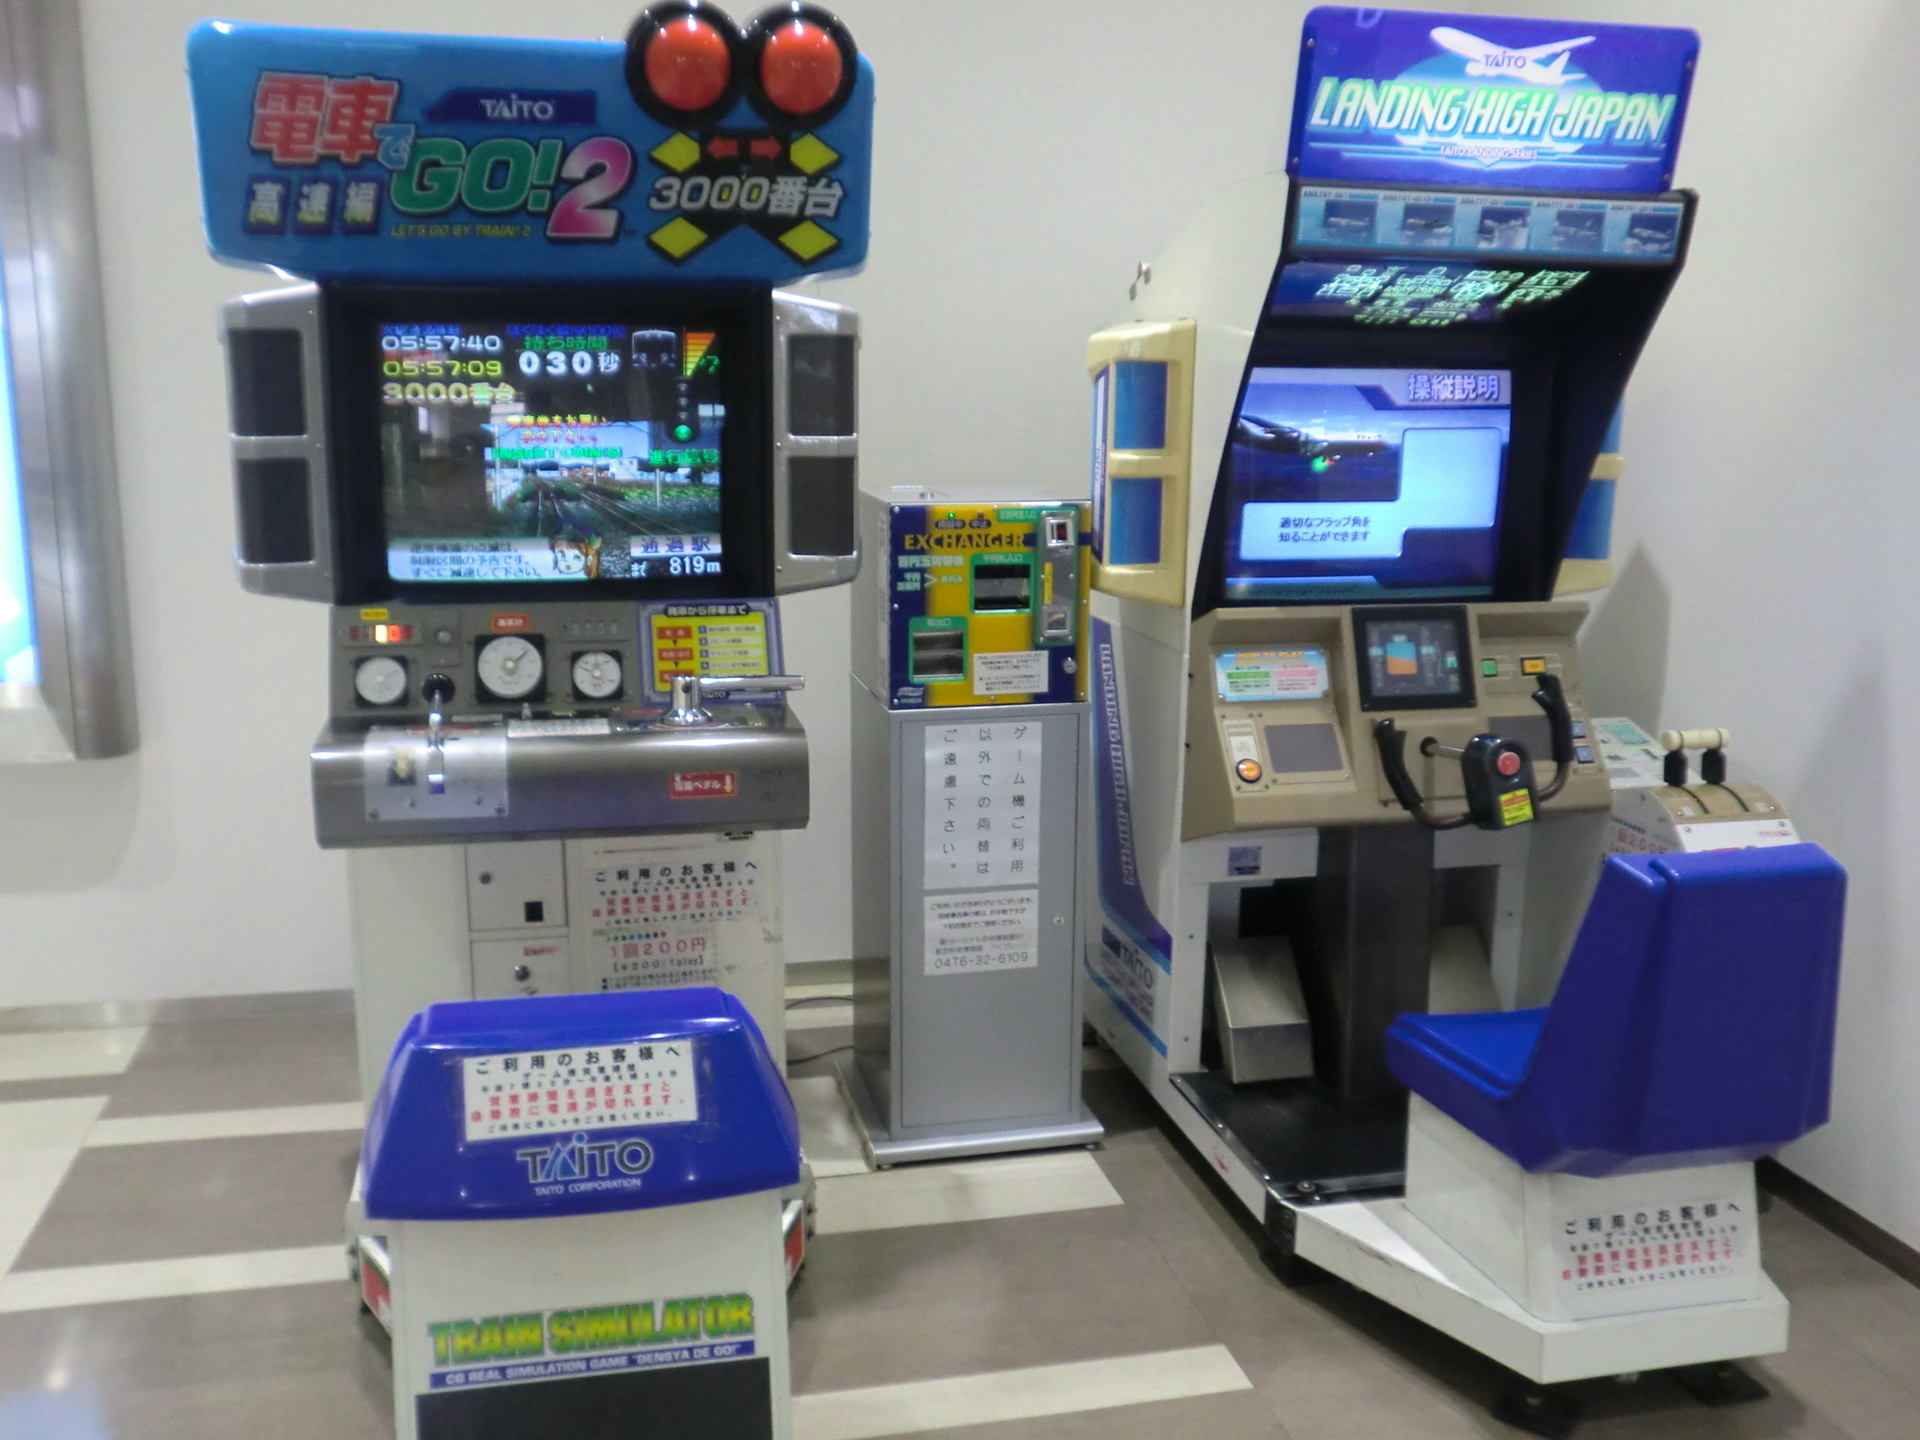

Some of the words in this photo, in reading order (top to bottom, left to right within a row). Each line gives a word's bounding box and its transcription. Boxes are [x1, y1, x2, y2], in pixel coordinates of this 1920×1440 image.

[1483, 50, 1526, 68] TAITO
[479, 93, 555, 120] TAITO
[1310, 76, 1464, 136] LANDING
[1464, 86, 1551, 140] HIGH
[1550, 91, 1676, 141] JAPAN
[546, 137, 632, 241] 2
[649, 174, 843, 218] 3000番台
[381, 335, 500, 350] 05:57:40
[524, 336, 609, 350] 持ち時間
[383, 360, 502, 376] 05:57:09
[1408, 374, 1499, 400] 操縦説明
[649, 449, 720, 465] 進行信号
[1280, 517, 1371, 528] 適切なフラップ角を
[641, 536, 710, 554] 通過駅
[904, 533, 1025, 550] EXCHANGER
[1278, 530, 1371, 542] 知ることができます
[977, 727, 992, 874] 以外での両替は
[1010, 725, 1027, 873] ゲーム機ご利用
[596, 862, 757, 883] ご利用のお客様へ
[934, 951, 1028, 969] 0476-32-6109
[476, 1047, 680, 1075] ご利用のお客様へ
[517, 1132, 654, 1183] TAITO
[534, 1184, 564, 1196] TAITO
[568, 1178, 642, 1193] CORPORATION
[428, 1312, 545, 1366] TRAIN
[548, 1292, 755, 1355] SIMULATOR
[469, 1368, 502, 1384] REAL
[506, 1360, 585, 1380] SIMULATION
[590, 1355, 628, 1369] GAME
[694, 1346, 710, 1359] DE
